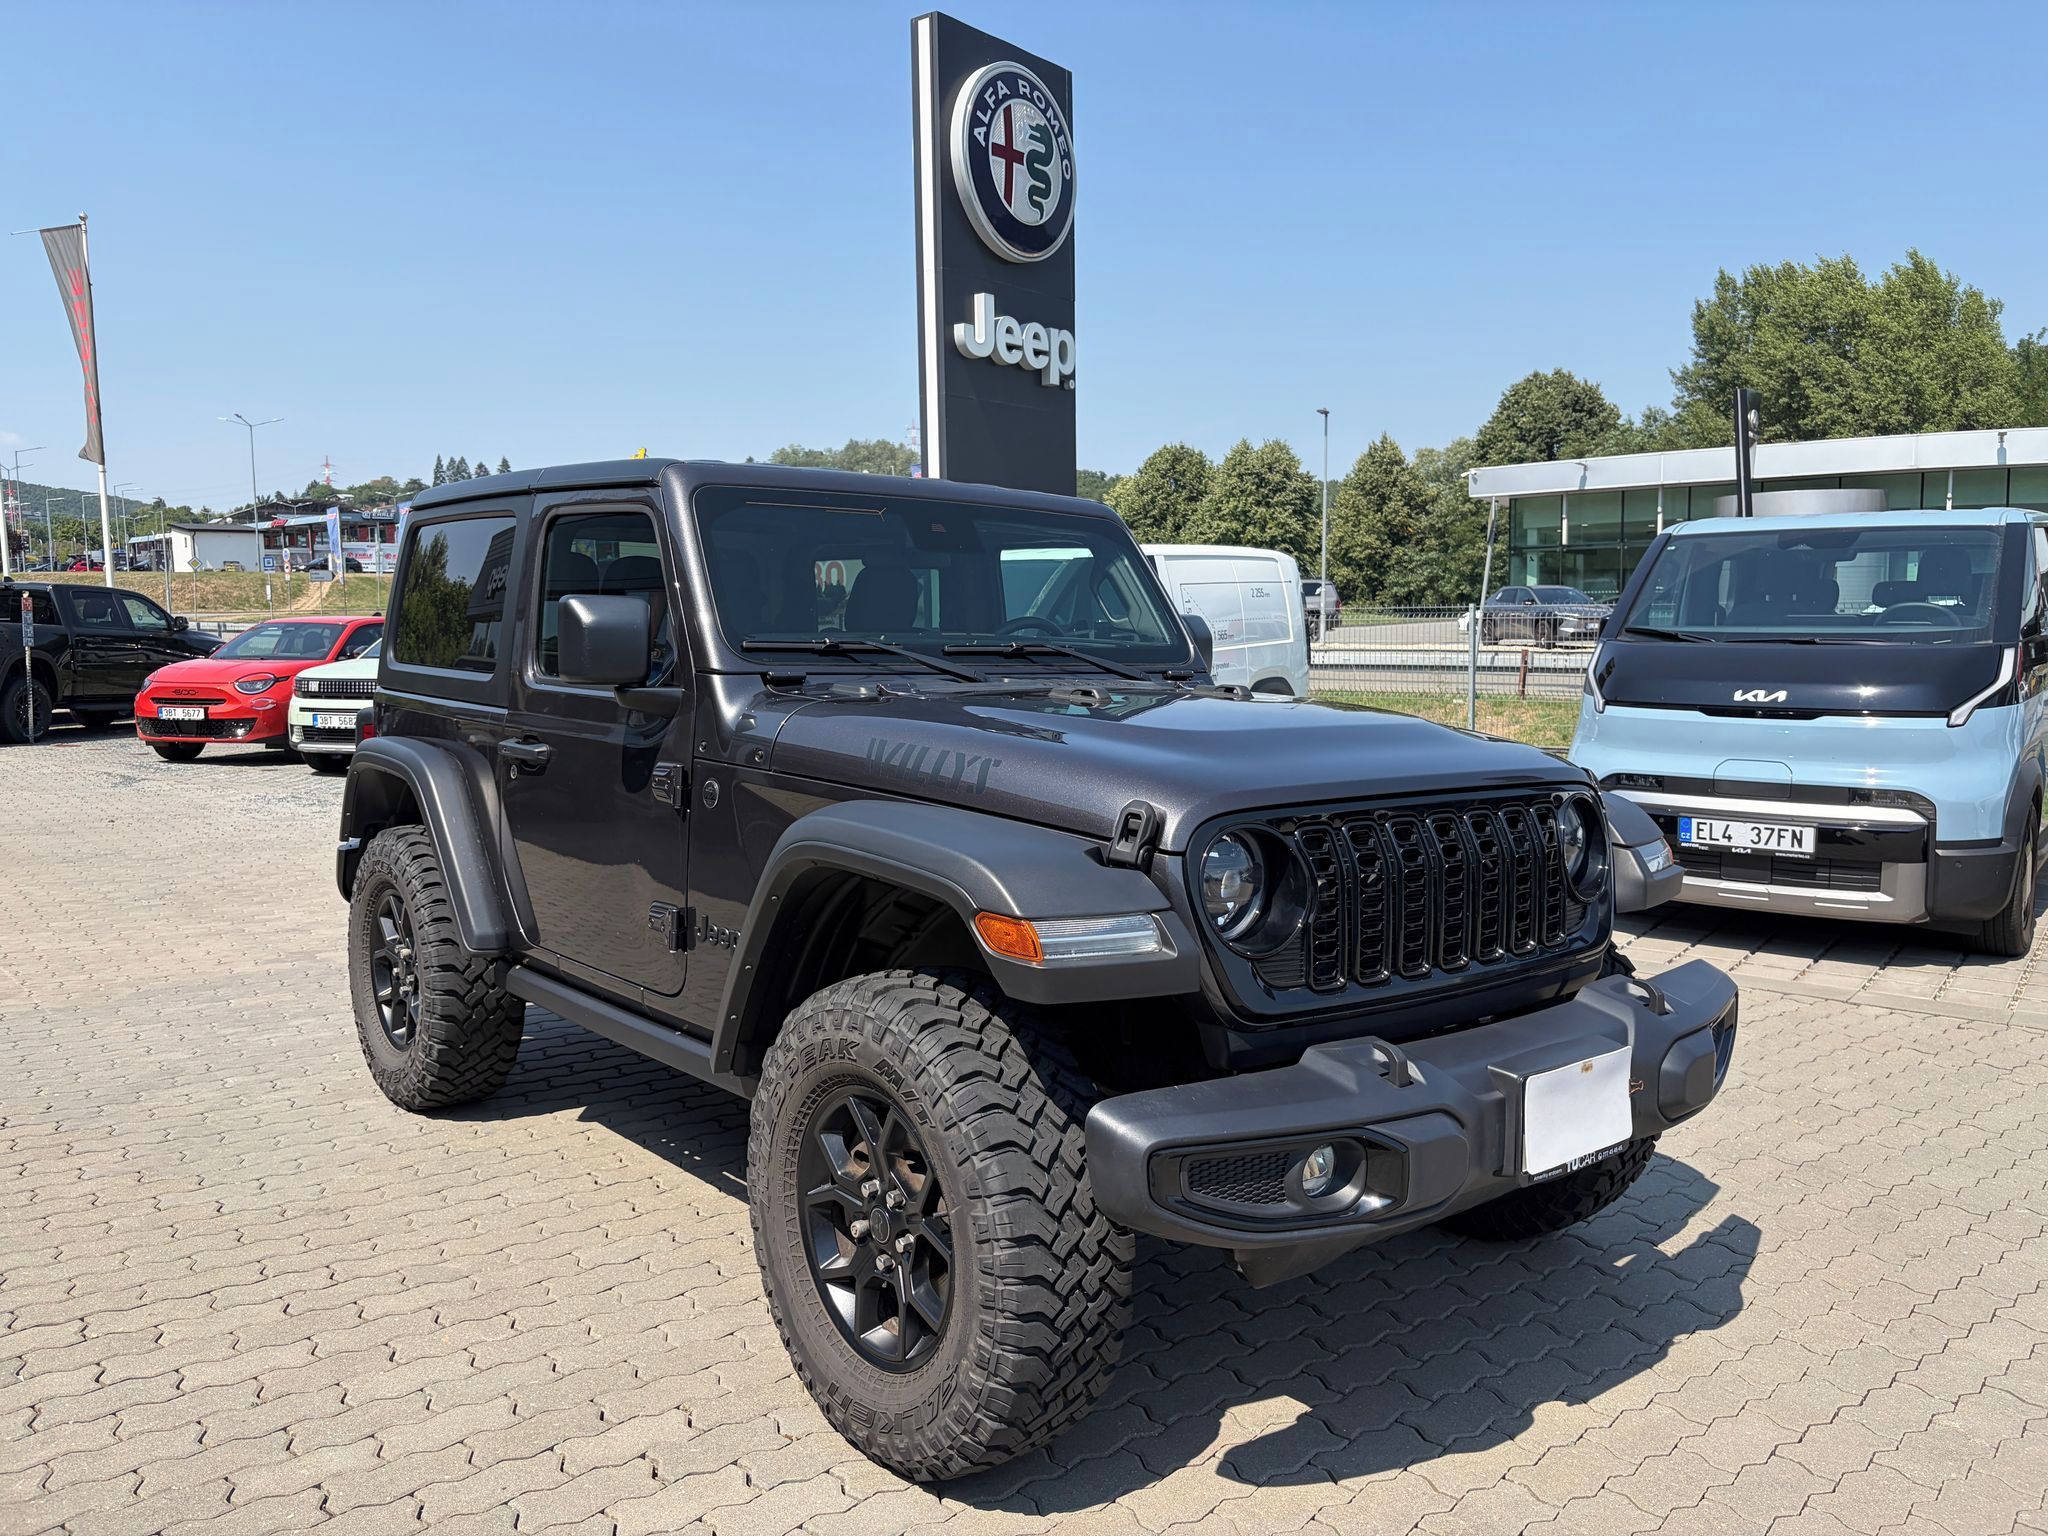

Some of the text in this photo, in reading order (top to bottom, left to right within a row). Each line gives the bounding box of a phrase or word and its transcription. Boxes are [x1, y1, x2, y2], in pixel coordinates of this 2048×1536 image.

[973, 78, 1072, 181] ALFA ROMEO
[954, 293, 1075, 388] Jeep
[163, 708, 201, 718] 3BT 5677
[319, 716, 333, 726] 3BT
[1696, 821, 1804, 849] EL4 37FN
[1566, 1151, 1596, 1173] TUCAR
